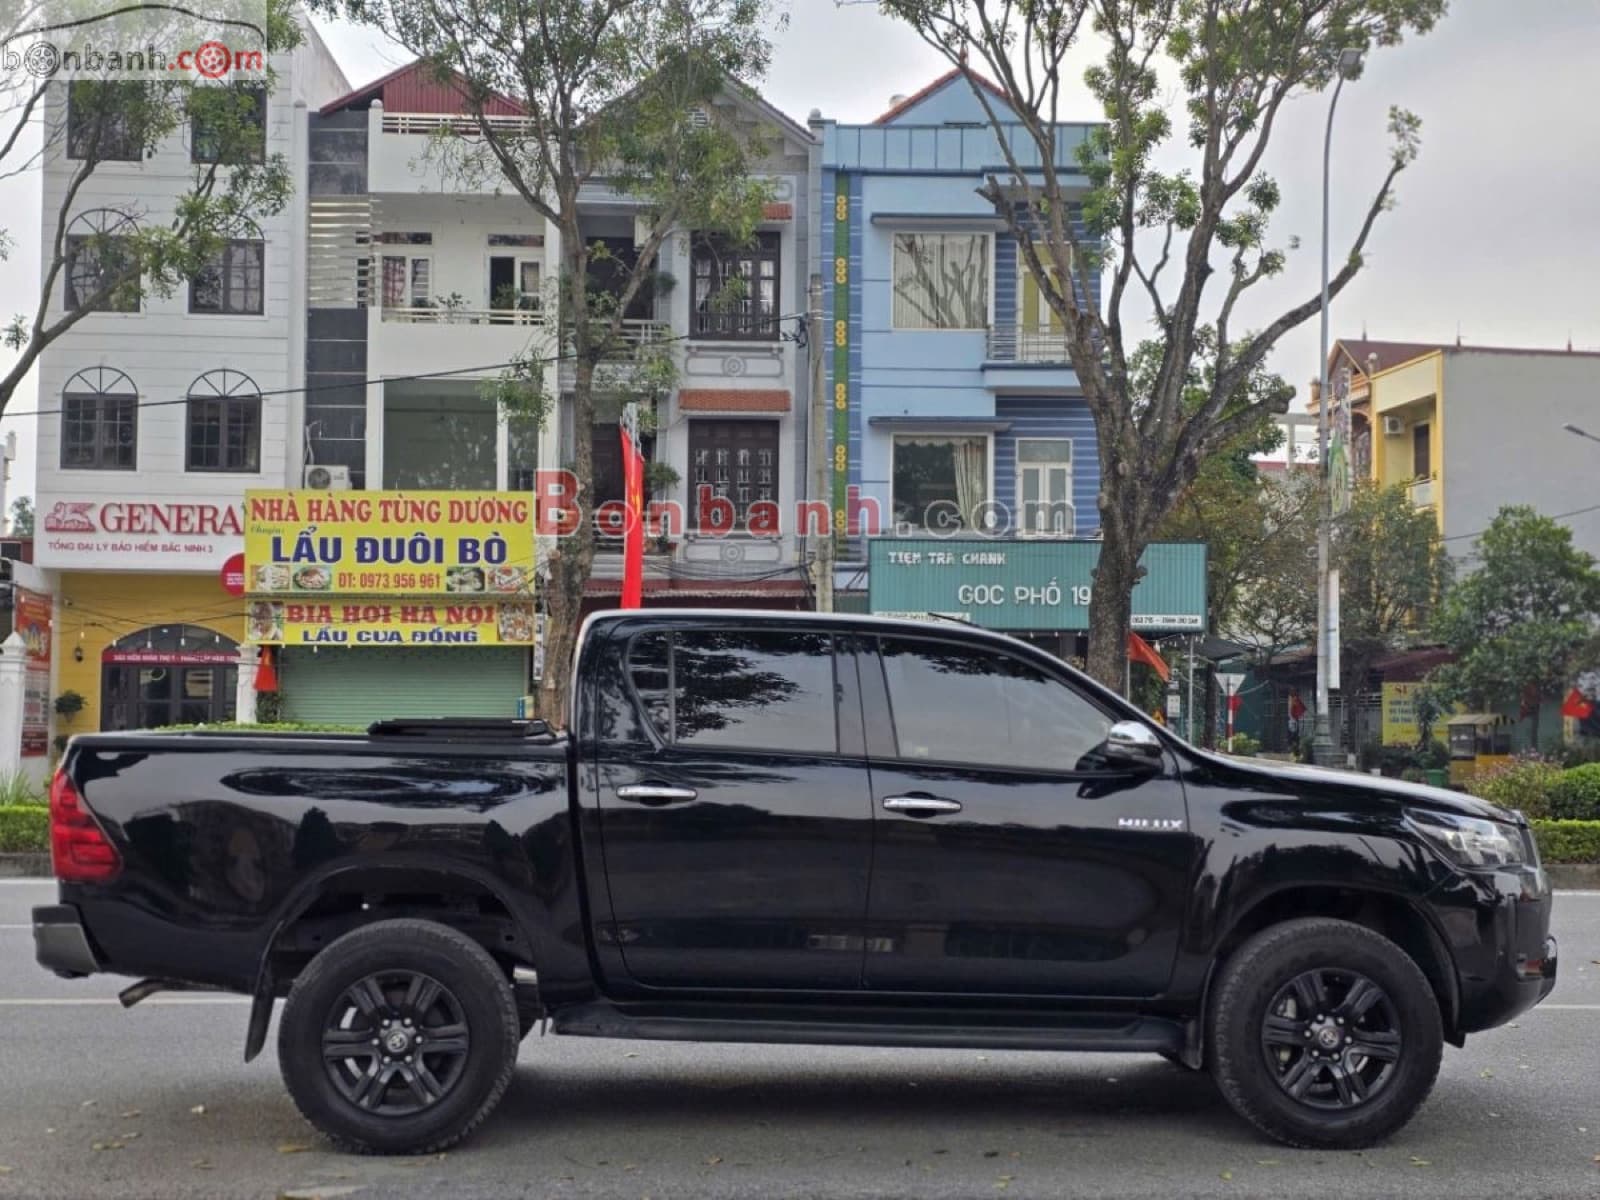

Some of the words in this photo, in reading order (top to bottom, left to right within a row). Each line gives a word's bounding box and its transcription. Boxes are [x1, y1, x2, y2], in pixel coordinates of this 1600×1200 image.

[250, 492, 300, 522] NHÀ
[306, 492, 373, 523] HÀNG
[378, 493, 442, 524] TÙNG
[448, 497, 529, 524] DƯƠNG
[272, 525, 342, 563] LẨU
[355, 532, 444, 564] ĐUÔI
[458, 531, 507, 564] BÒ
[360, 572, 391, 589] 0973
[394, 573, 416, 589] 956
[1014, 576, 1061, 605] PHỐ
[286, 604, 333, 624] BIA
[356, 630, 403, 643] CUA
